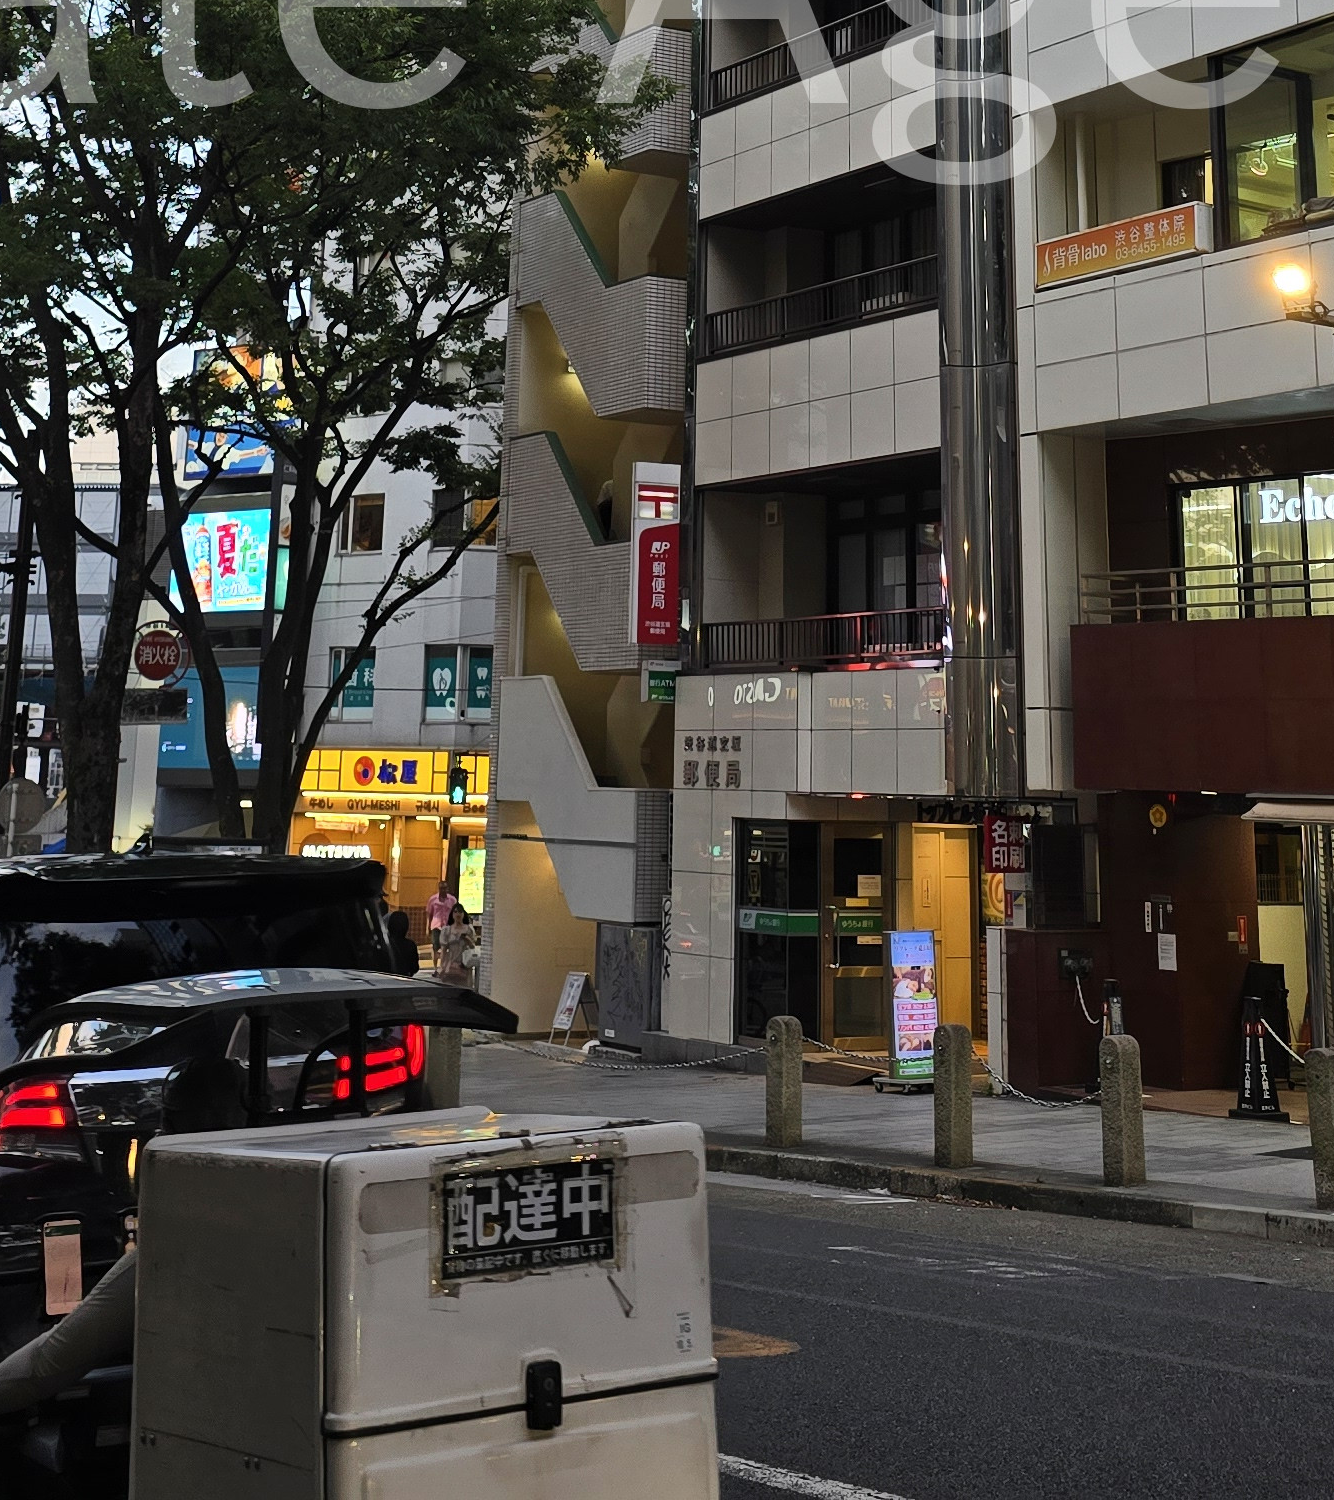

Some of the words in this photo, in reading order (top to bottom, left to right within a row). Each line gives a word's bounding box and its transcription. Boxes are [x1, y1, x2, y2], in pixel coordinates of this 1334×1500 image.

[1114, 214, 1186, 247] 渋谷整体院
[1051, 242, 1108, 271] 背骨labo
[1115, 232, 1186, 262] 03-6455-1495
[650, 560, 667, 610] 郵便局
[138, 645, 178, 665] 消火栓
[683, 735, 742, 752] 渋谷道玄坂
[376, 758, 418, 785] 松屋
[682, 759, 742, 788] 郵便局
[991, 819, 1025, 844] 名刺
[991, 845, 1026, 869] 印刷
[443, 1163, 610, 1249] 配達中
